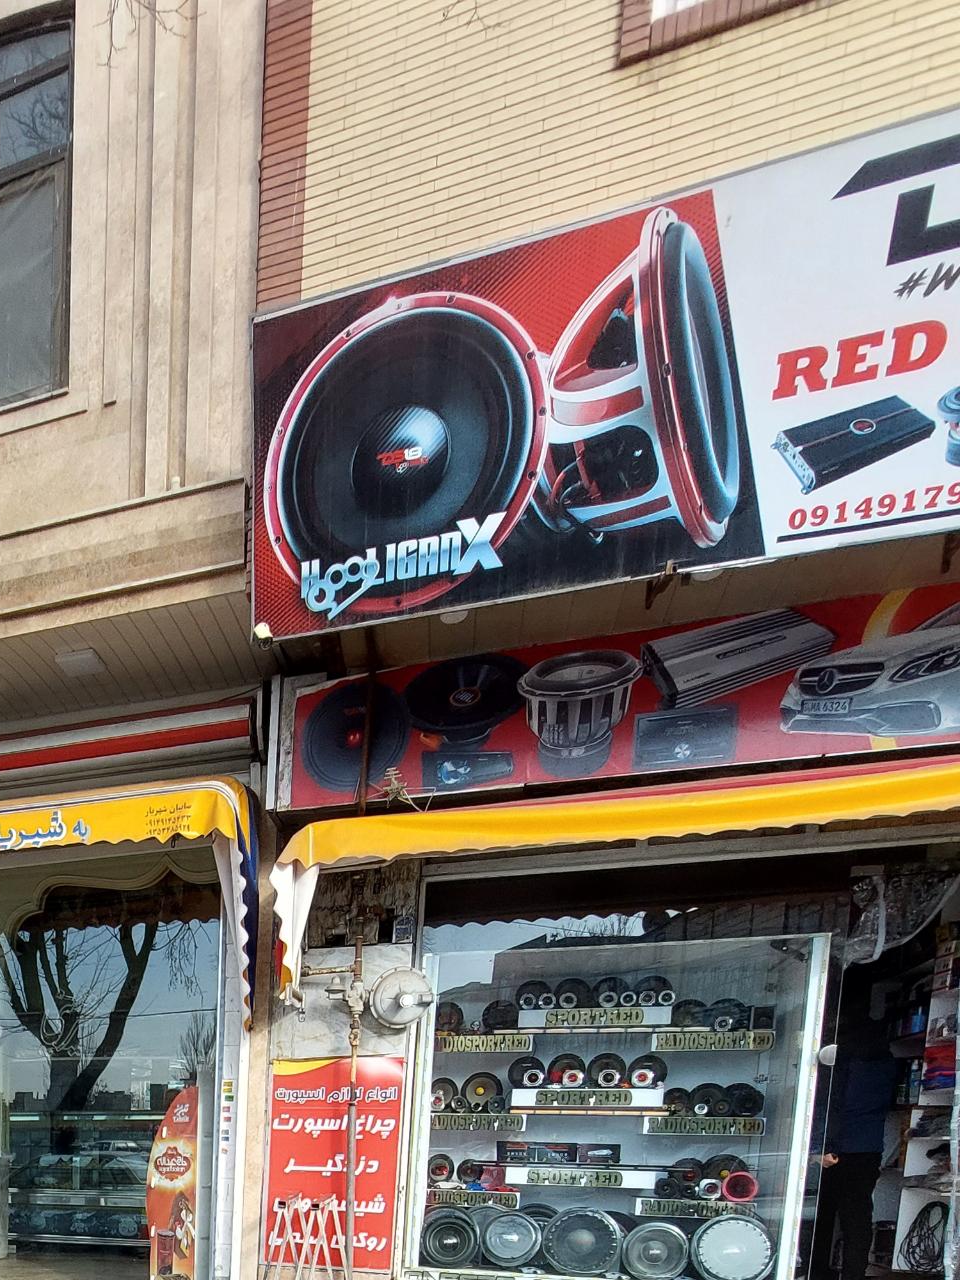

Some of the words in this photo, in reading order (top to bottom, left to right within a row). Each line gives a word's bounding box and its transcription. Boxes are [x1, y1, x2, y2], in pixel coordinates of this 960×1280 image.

[772, 320, 948, 401] RED
[72, 819, 89, 842] به
[545, 1009, 603, 1027] SPORT
[604, 1008, 644, 1025] RED
[436, 1035, 503, 1052] DIOSPORT
[274, 1087, 325, 1104] اسپورت
[365, 1087, 398, 1103] انواع
[535, 1091, 592, 1106] SPORT
[594, 1090, 633, 1105] RED
[272, 1113, 348, 1138] اسپورت
[355, 1114, 396, 1140] چراغ
[431, 1114, 496, 1131] ADIOSPORT
[527, 1169, 582, 1186] SPORT
[586, 1171, 623, 1187] RED
